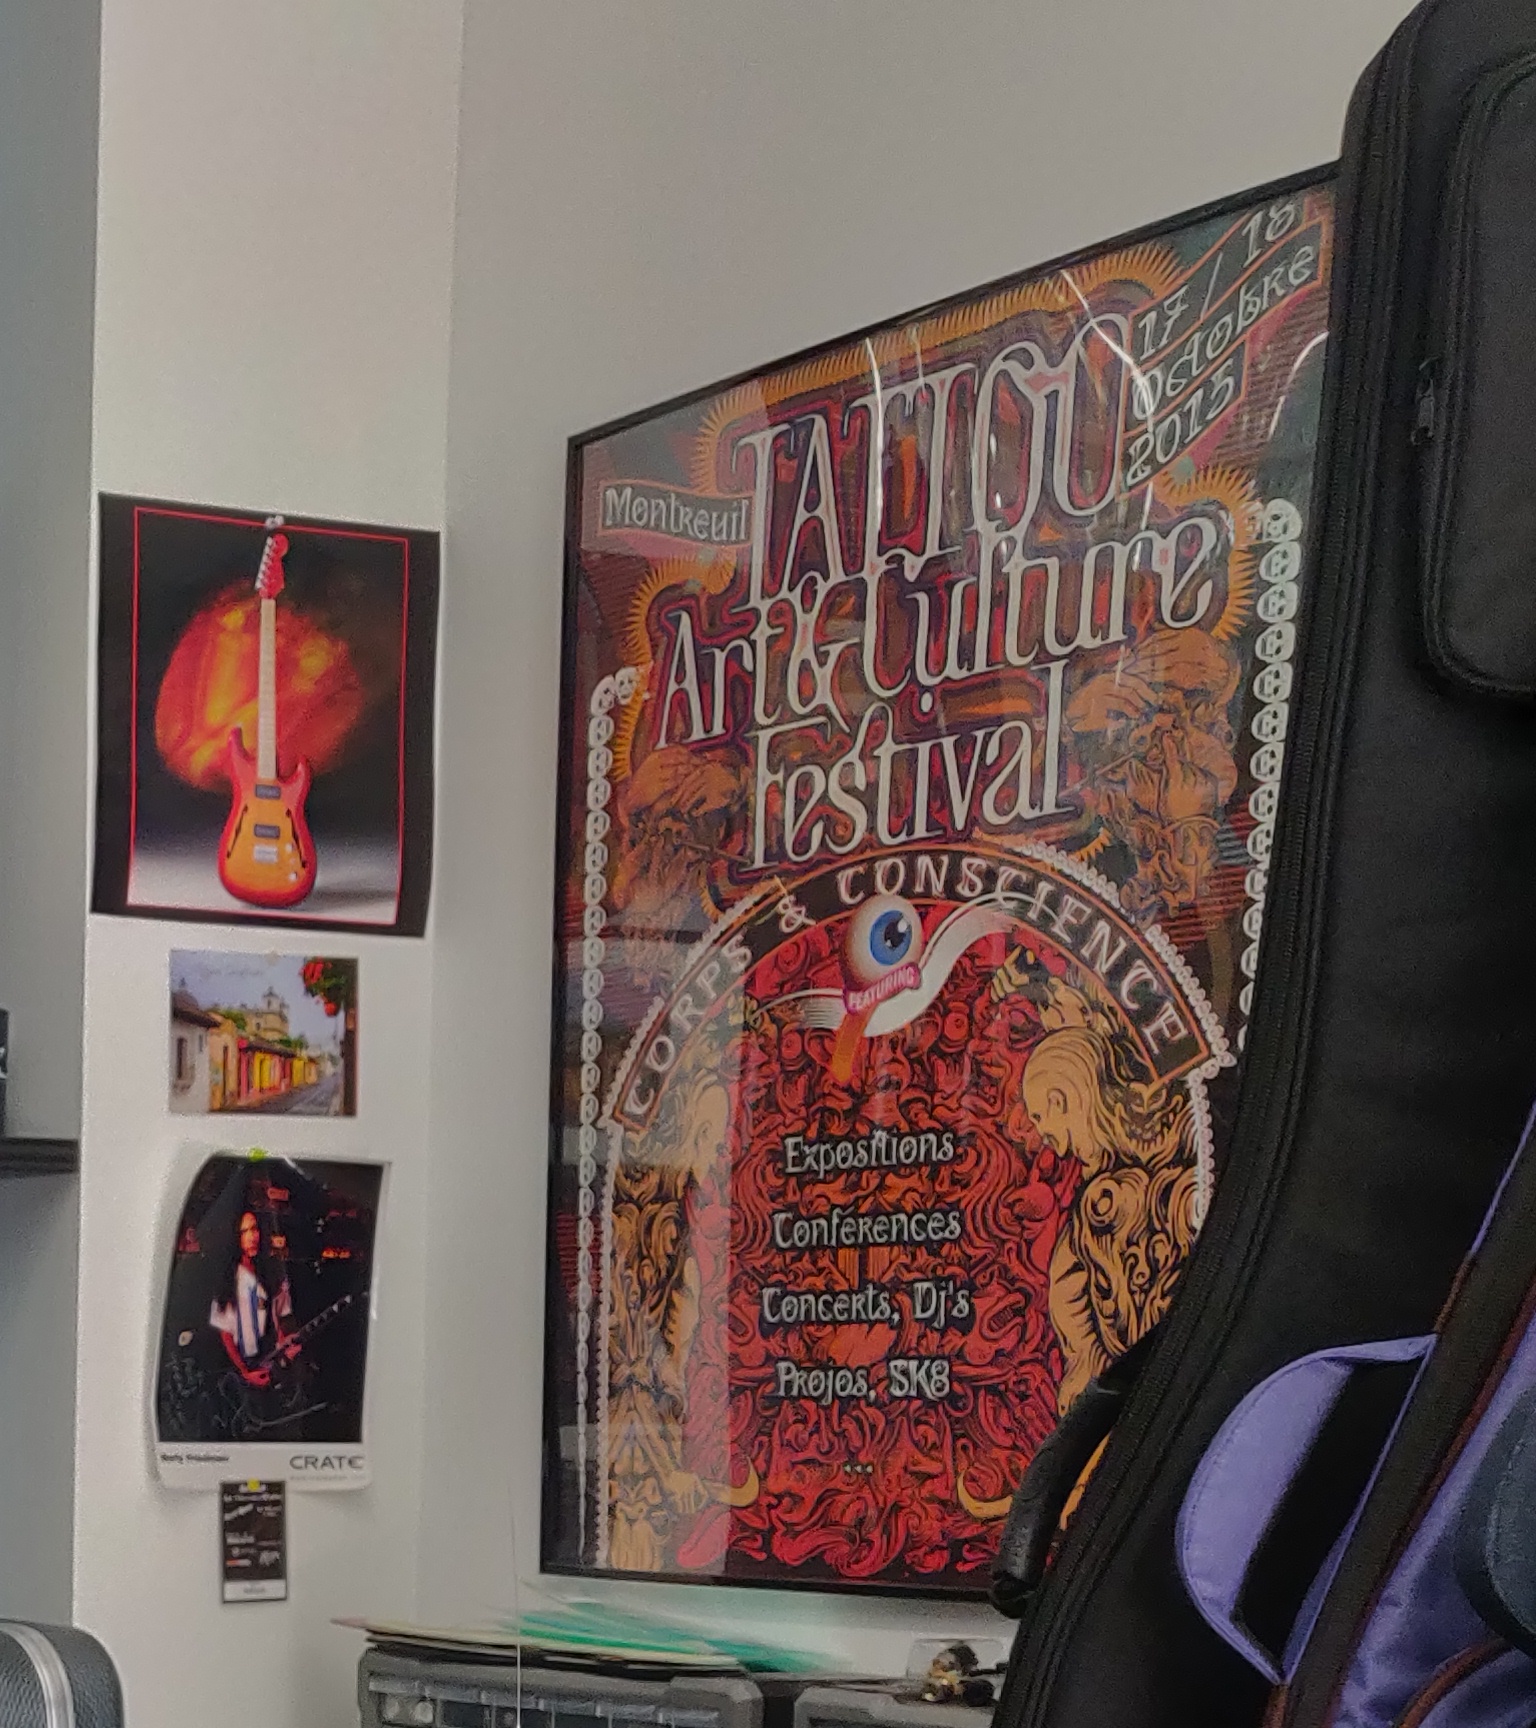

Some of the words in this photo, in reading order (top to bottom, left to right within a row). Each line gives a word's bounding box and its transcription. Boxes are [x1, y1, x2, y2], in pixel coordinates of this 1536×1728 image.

[1137, 285, 1189, 361] 17
[1241, 200, 1296, 268] 18
[1126, 357, 1235, 484] 2015
[603, 485, 749, 543] Montreuil
[744, 662, 1077, 871] Festival
[624, 931, 753, 1117] CORPS
[837, 854, 1189, 1057] CONSCIENCE
[848, 964, 920, 1010] FEATURING
[784, 1129, 955, 1179] Expositions
[772, 1206, 963, 1249] Conférences
[761, 1282, 901, 1325] Concerts,
[912, 1280, 971, 1329] Dj's
[775, 1361, 877, 1406] Projos,
[888, 1358, 951, 1401] SK8
